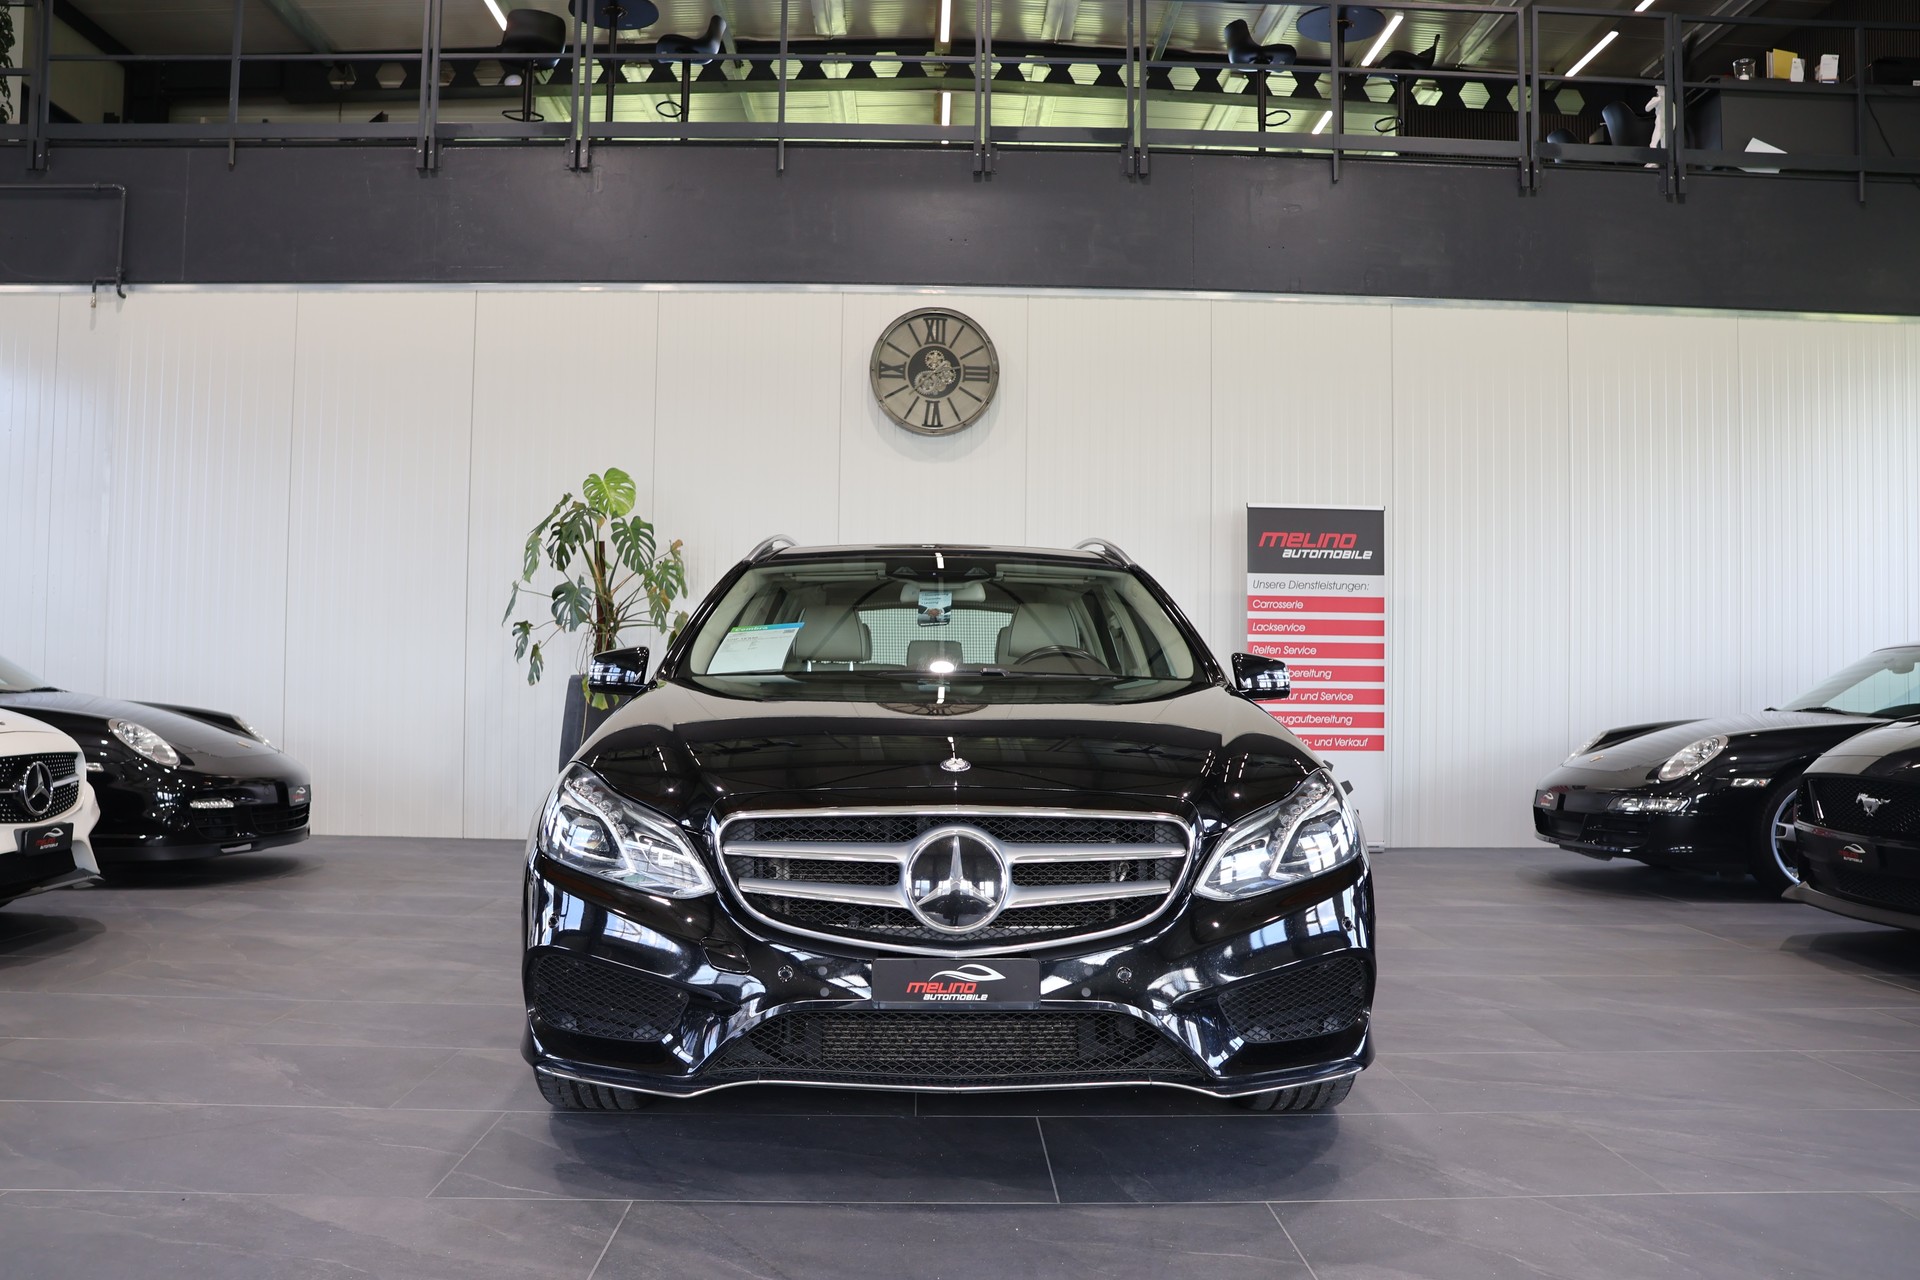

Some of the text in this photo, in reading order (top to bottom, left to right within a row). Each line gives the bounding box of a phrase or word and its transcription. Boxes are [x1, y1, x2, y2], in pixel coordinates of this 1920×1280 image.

[923, 318, 948, 345] XII
[1252, 580, 1370, 592] Unsere Dienstleistungen:
[1252, 600, 1304, 609] Carrosserie
[1252, 623, 1306, 632] Lackservice
[1252, 645, 1317, 655] Reifen Service
[1288, 669, 1332, 680] bereitung
[1300, 692, 1319, 700] und
[1320, 692, 1354, 701] Service
[1314, 737, 1332, 746] und
[1334, 737, 1369, 746] Verkauf
